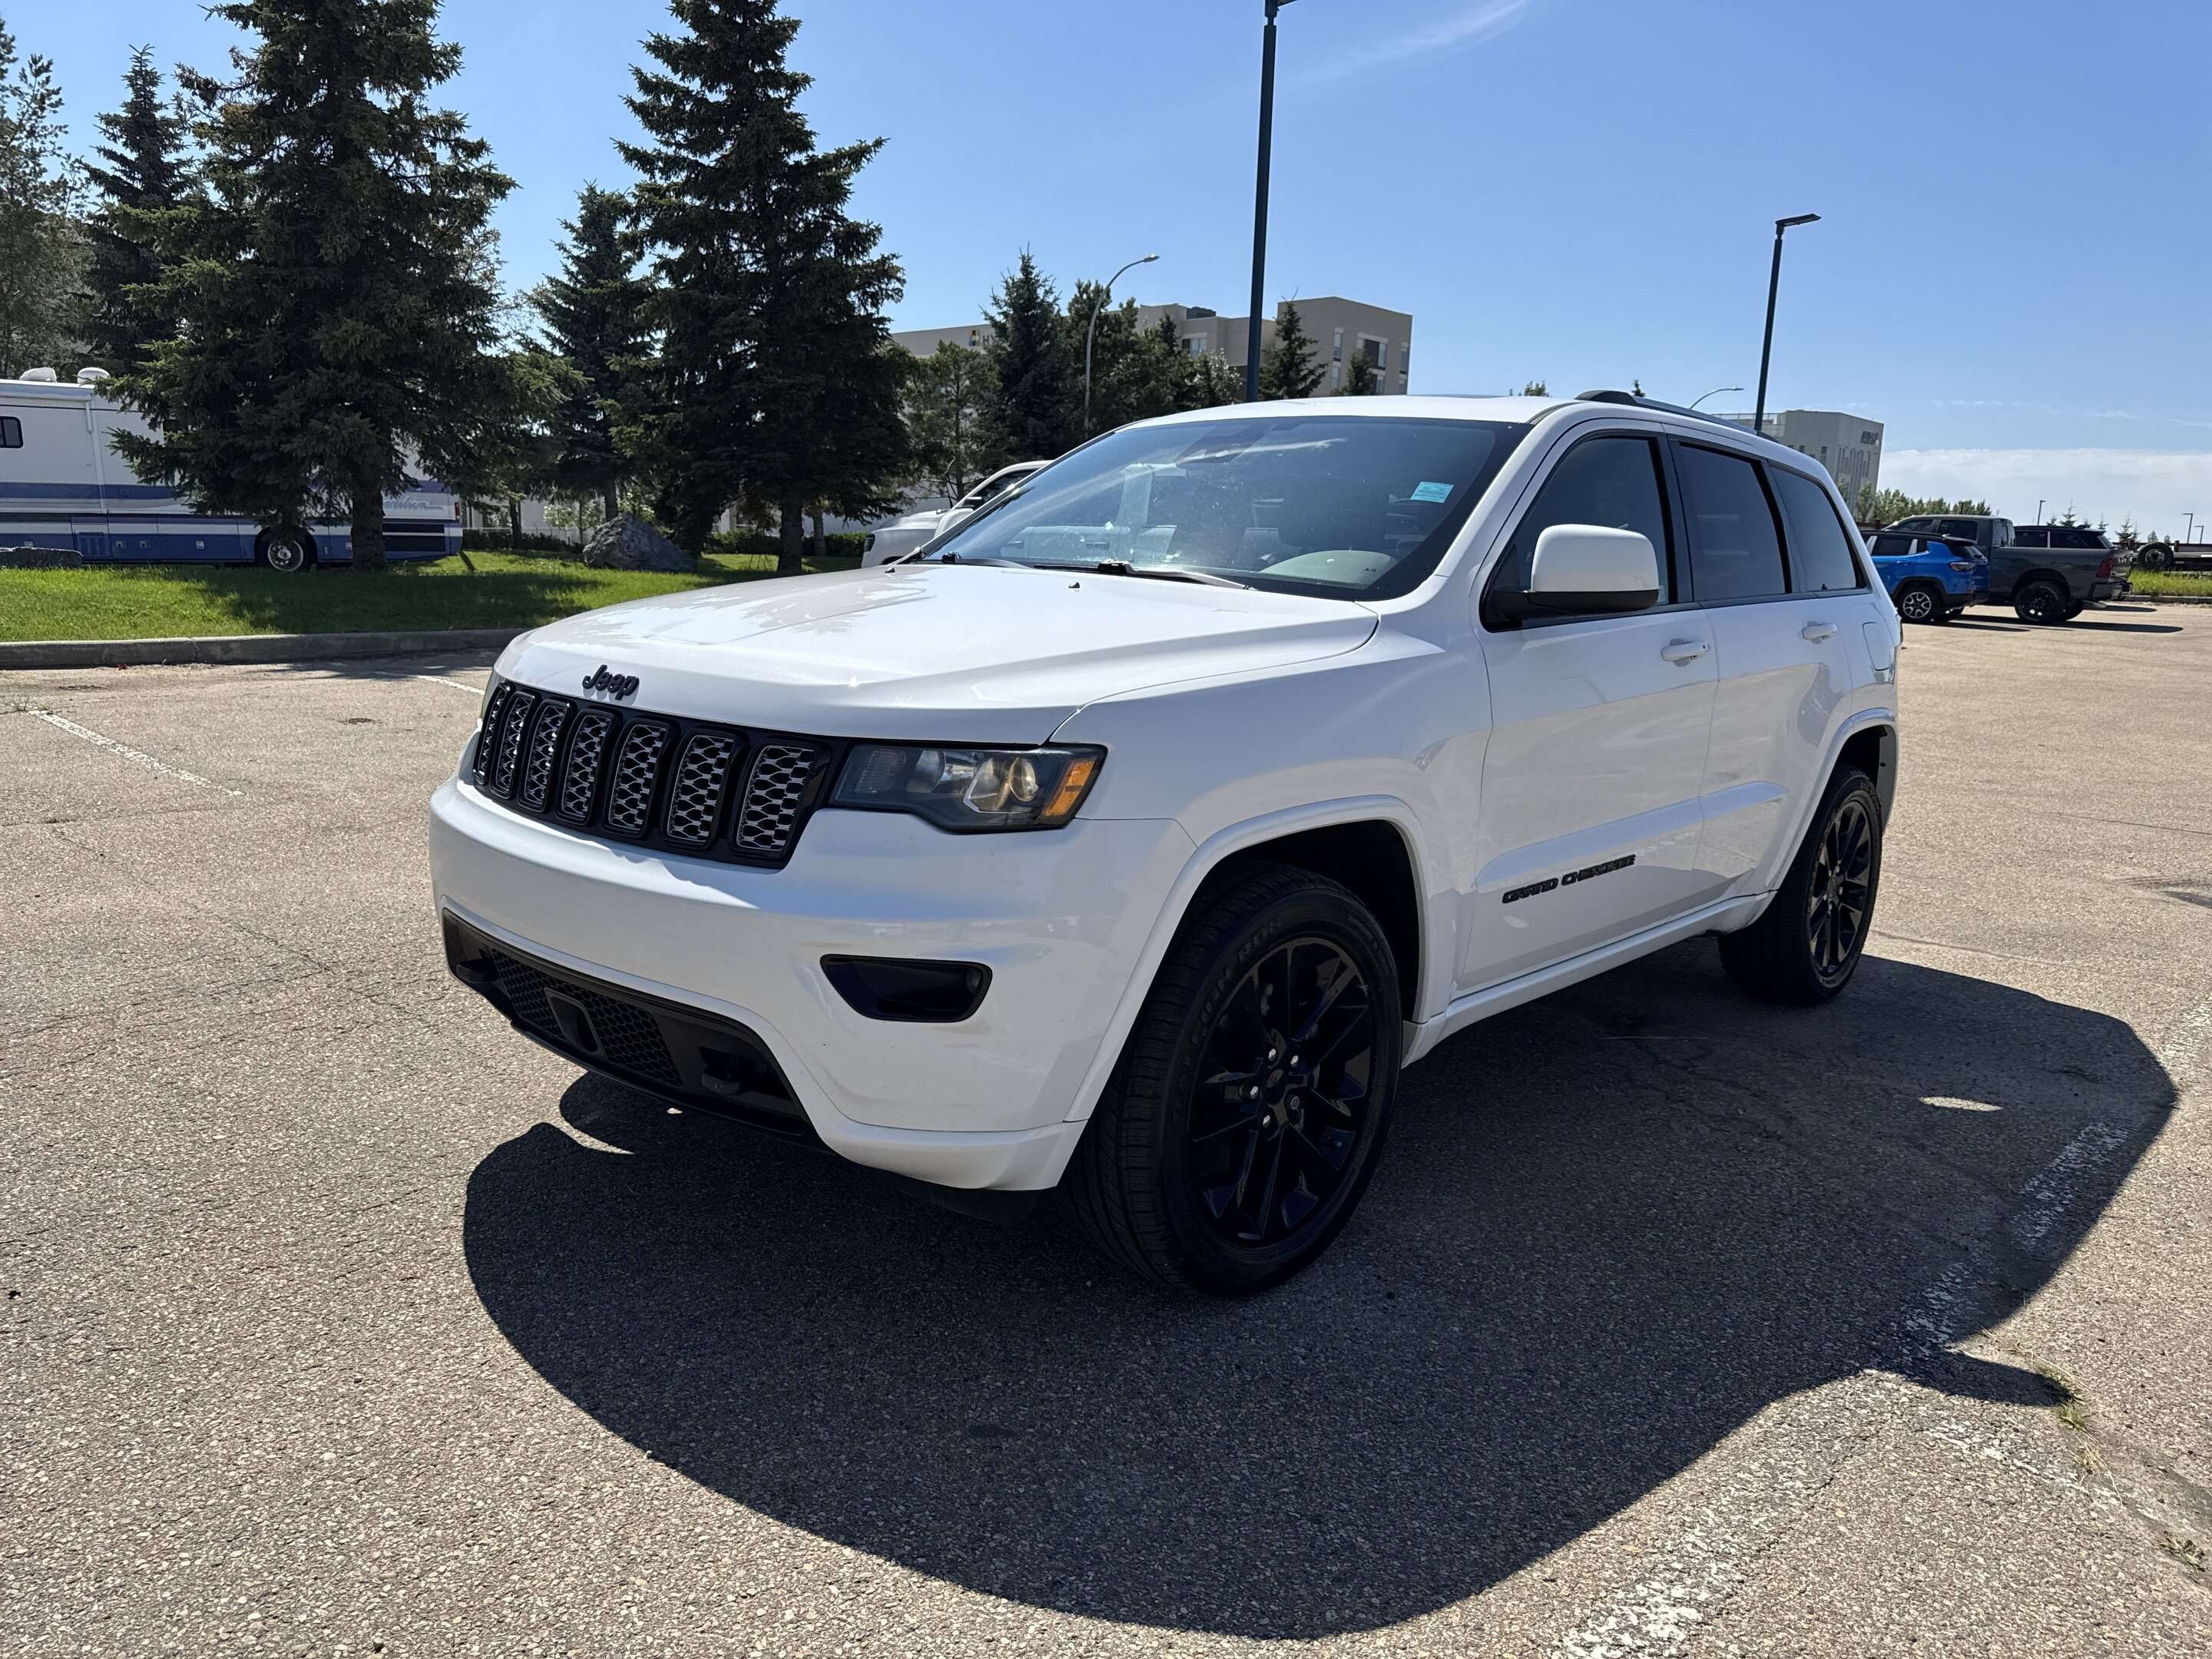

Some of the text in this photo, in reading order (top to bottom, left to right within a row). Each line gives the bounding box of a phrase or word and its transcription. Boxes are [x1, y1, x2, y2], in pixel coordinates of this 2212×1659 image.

[582, 664, 640, 700] Jeep
[1502, 854, 1636, 904] GRAND CHEROKEE
